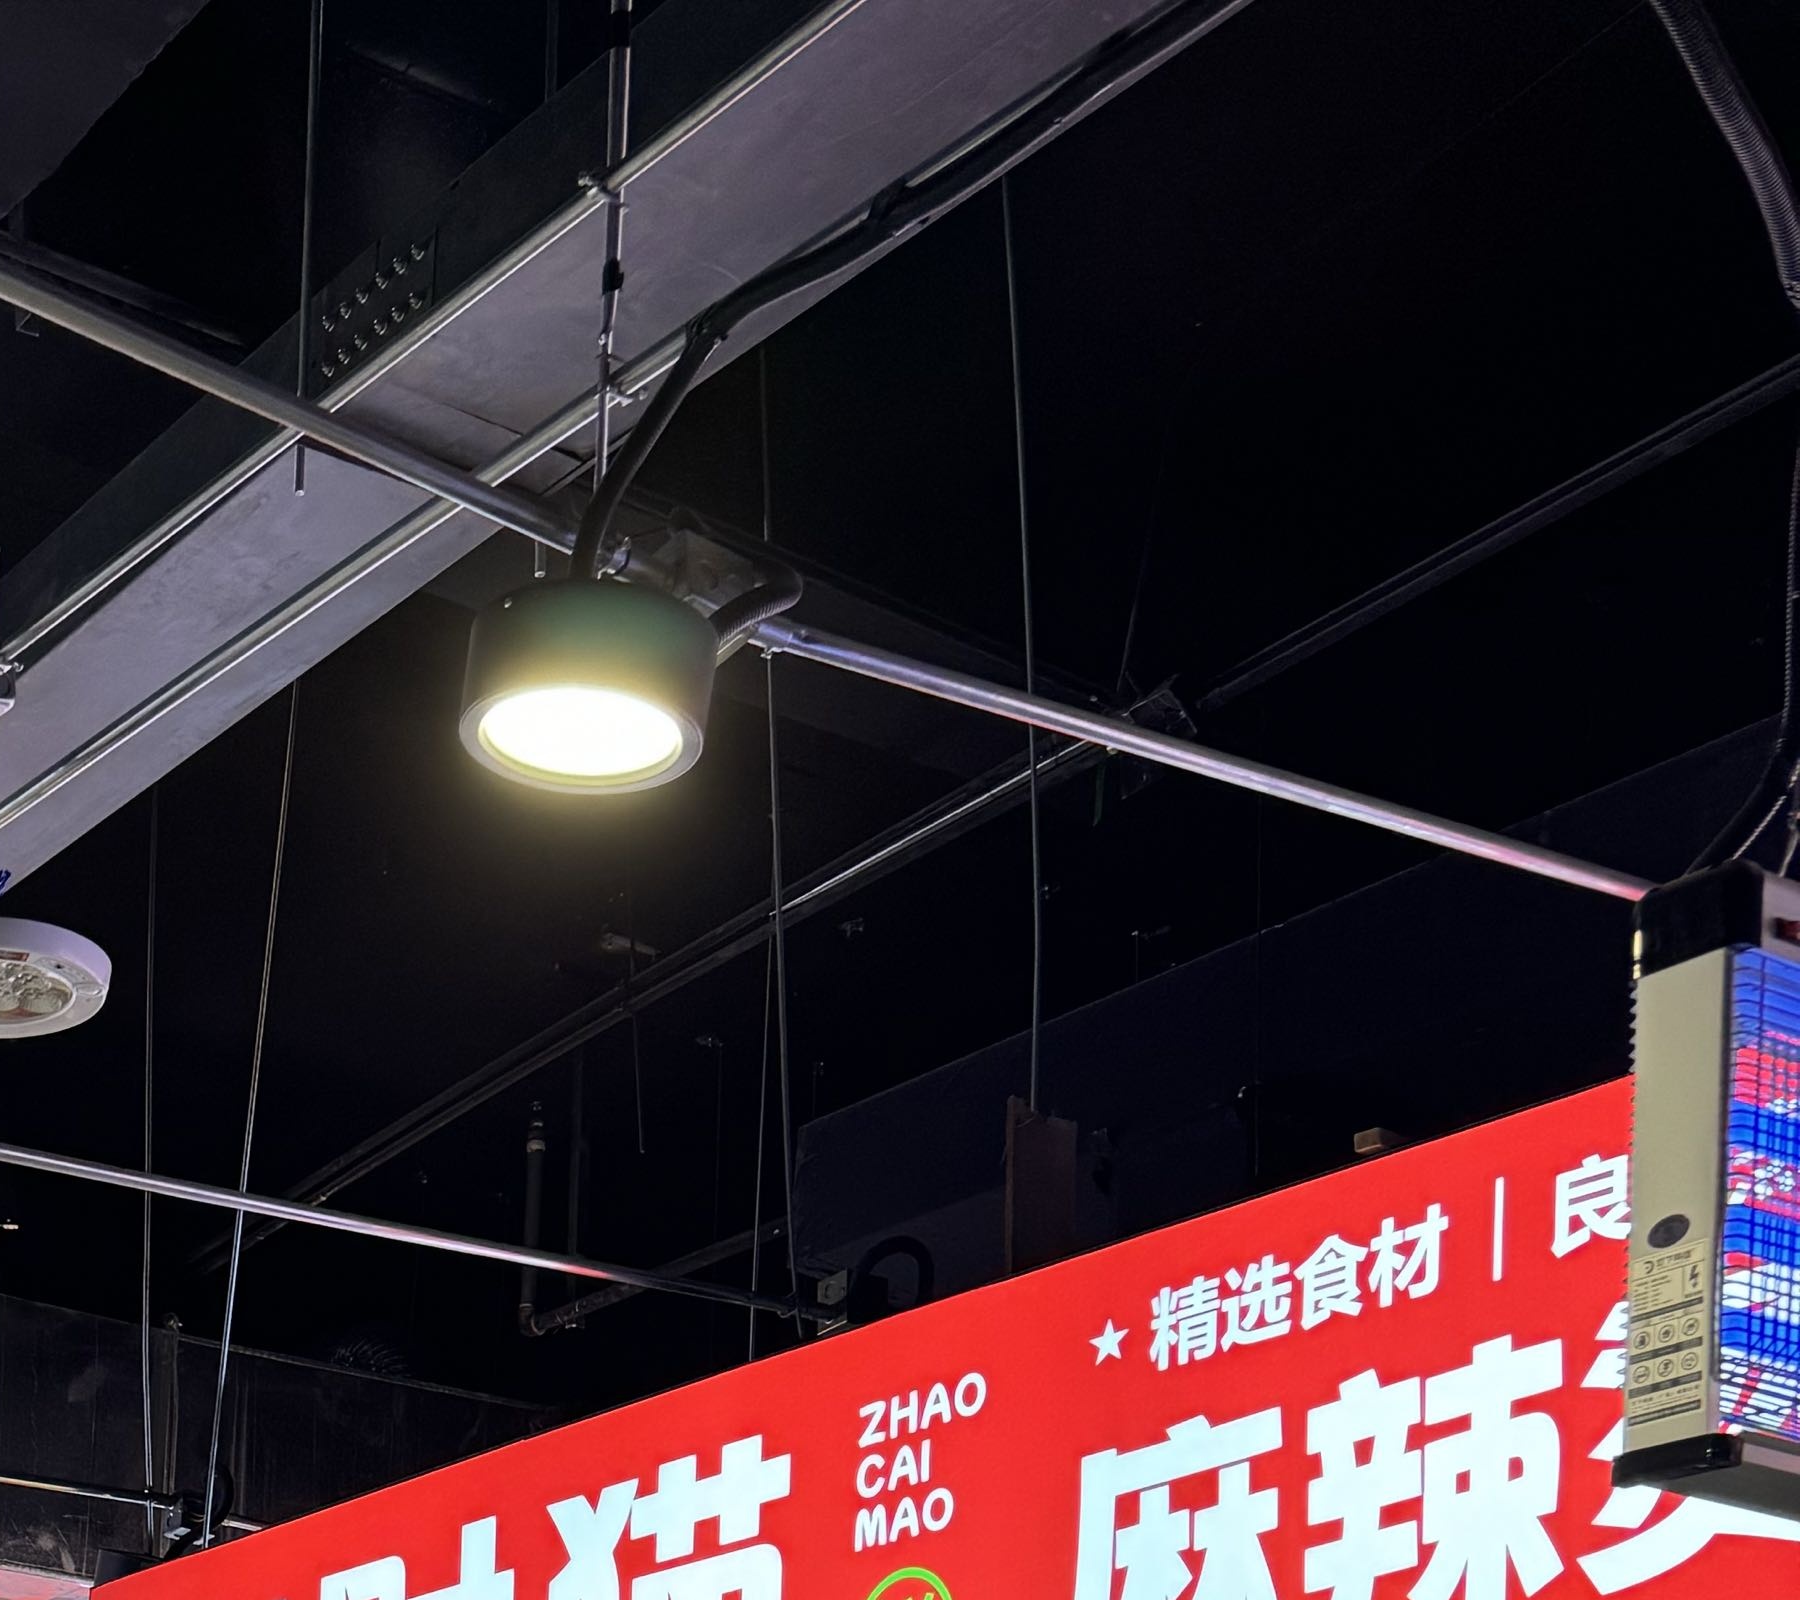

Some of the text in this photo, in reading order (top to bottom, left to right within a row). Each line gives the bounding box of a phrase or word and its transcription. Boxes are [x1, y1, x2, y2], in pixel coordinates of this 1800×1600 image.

[1150, 1203, 1449, 1372] 精选食材
[858, 1372, 987, 1449] ZHAO
[855, 1438, 931, 1499] CAI
[854, 1487, 955, 1553] MAO
